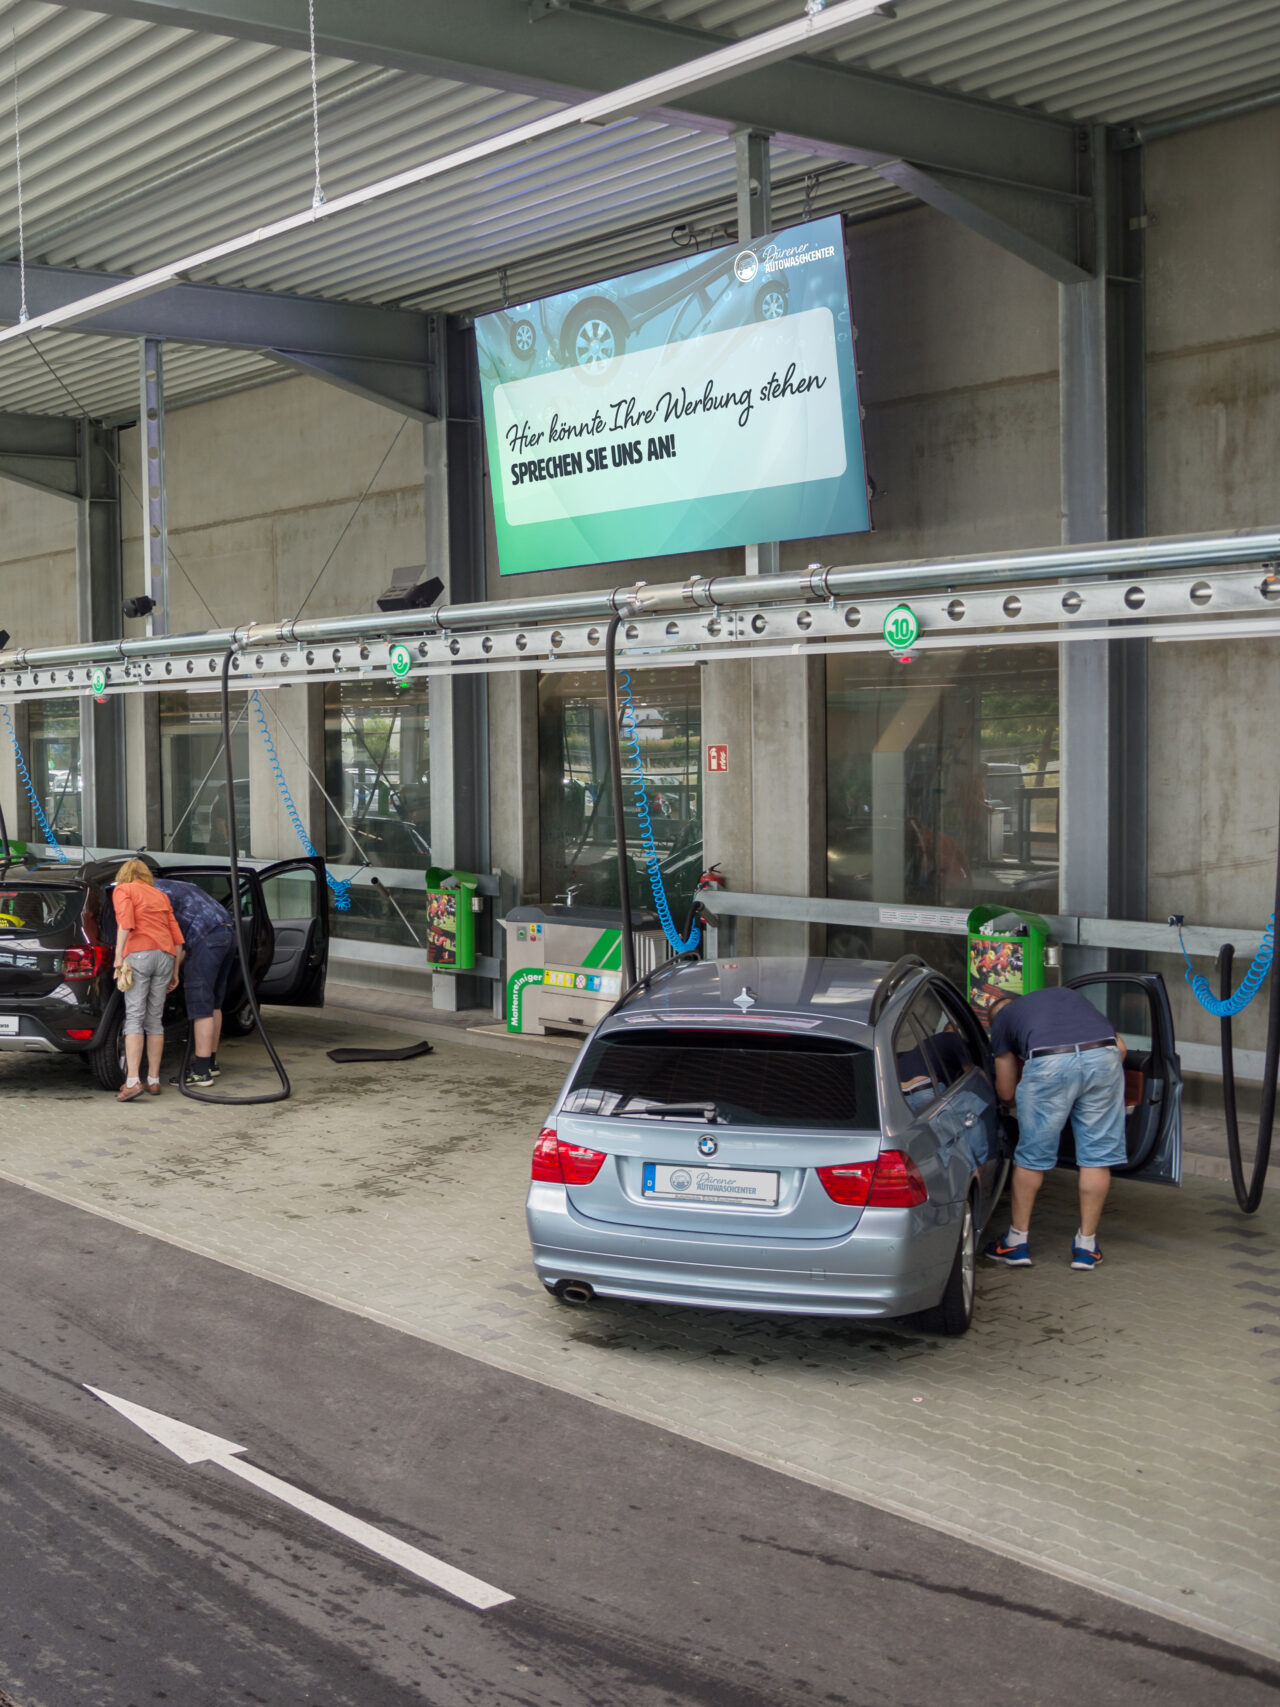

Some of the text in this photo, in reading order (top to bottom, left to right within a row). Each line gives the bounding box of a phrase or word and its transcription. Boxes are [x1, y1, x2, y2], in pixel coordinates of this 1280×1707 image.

[762, 243, 809, 262] Dürener
[765, 246, 835, 273] AUTOWASCHCENTER
[505, 363, 826, 454] Hier könnte Ihre Werbung stehen
[511, 434, 676, 486] SPRECHEN SIE UNS AN!
[892, 618, 909, 638] 10
[397, 653, 404, 668] 9
[511, 973, 543, 1026] Mattenreiniger
[696, 1184, 757, 1195] AUTOWASCHCENTER
